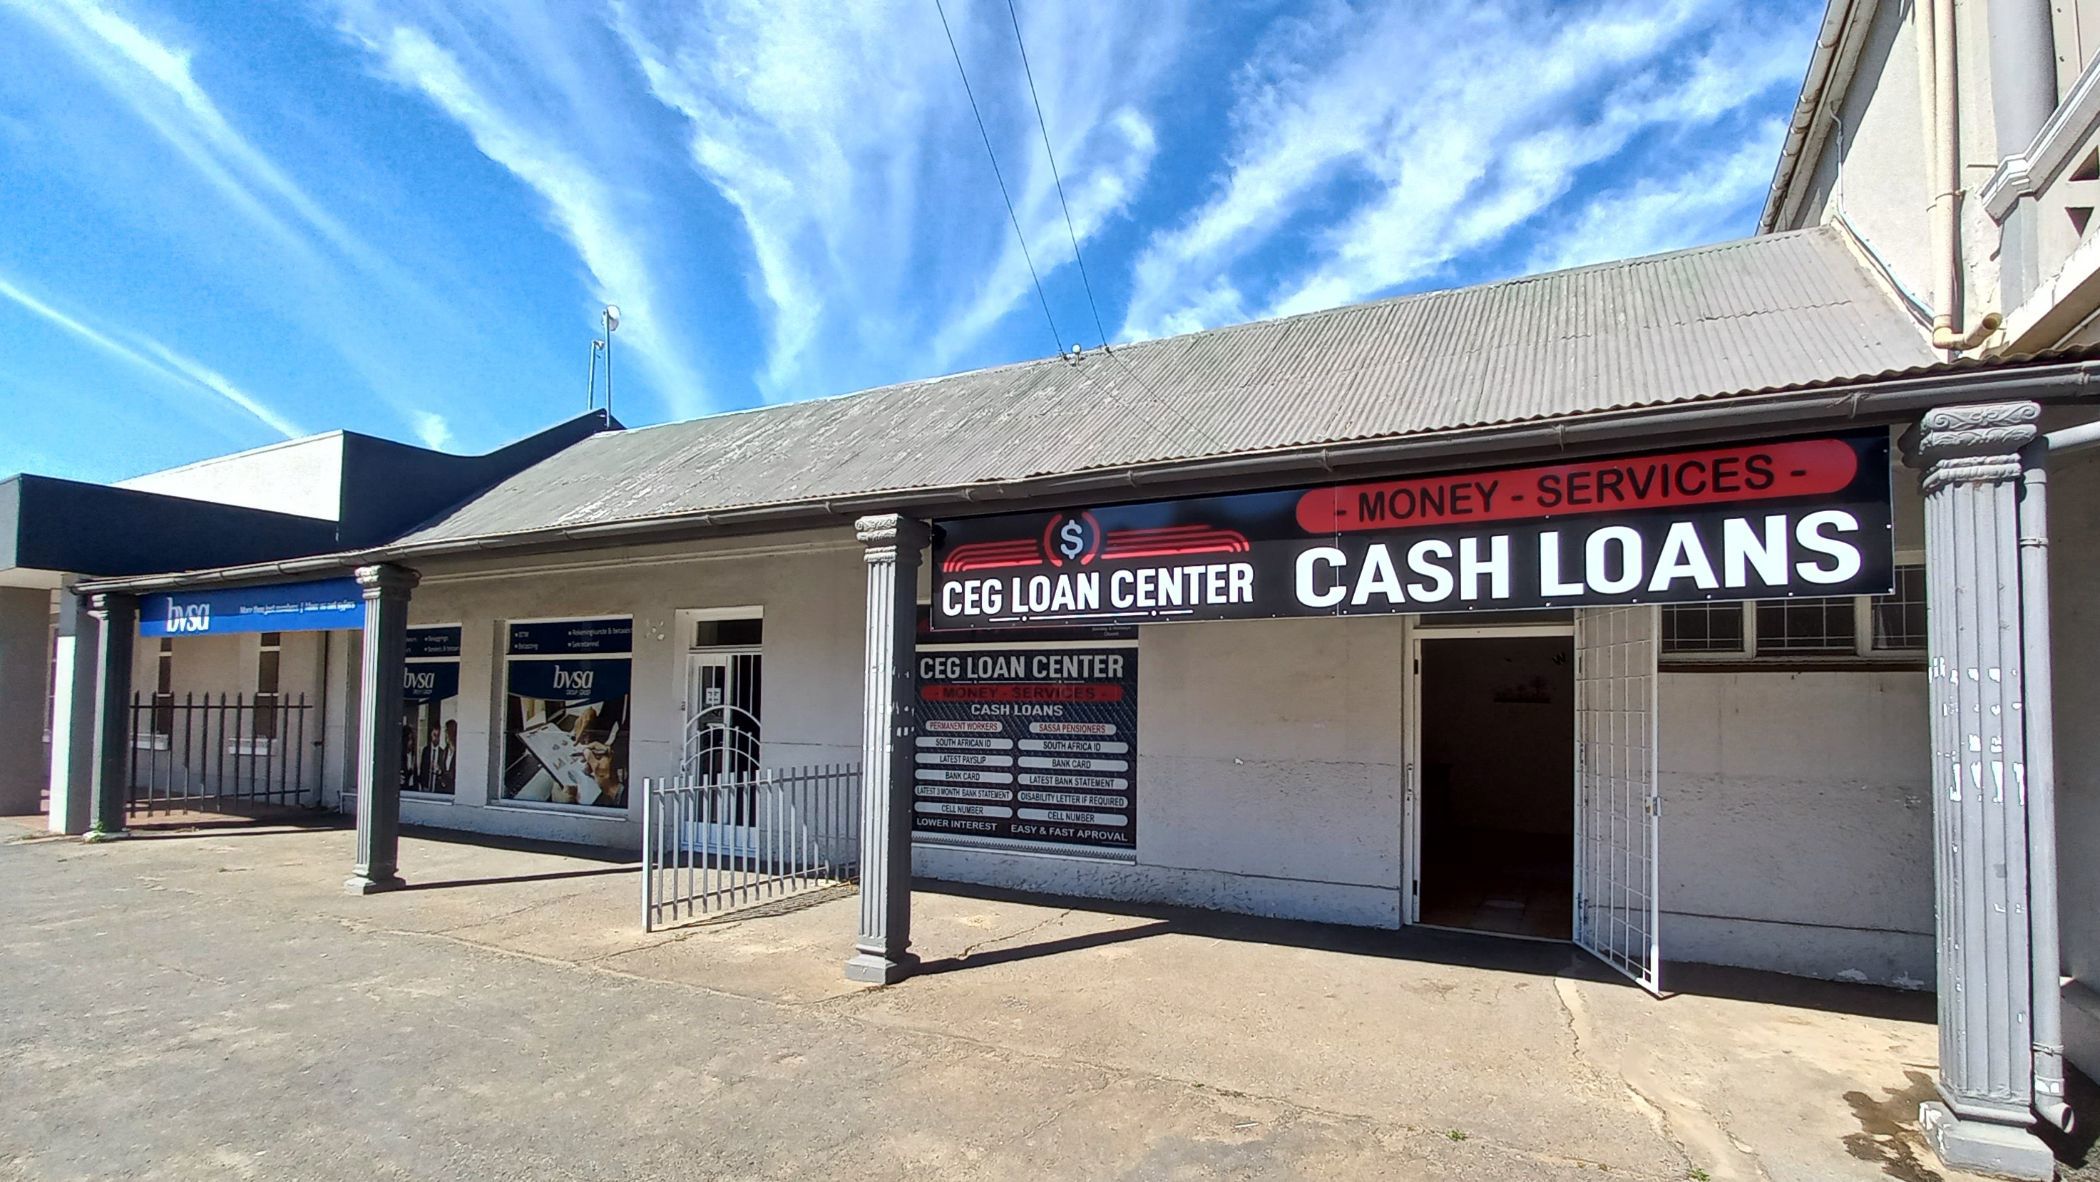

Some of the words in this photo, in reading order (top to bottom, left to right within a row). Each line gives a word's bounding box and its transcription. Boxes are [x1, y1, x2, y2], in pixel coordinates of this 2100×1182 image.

[1358, 481, 1499, 522] MONEY
[1535, 454, 1775, 508] SERVICES
[1294, 535, 1510, 608] CASH
[1539, 510, 1861, 597] LOANS
[942, 578, 1002, 616] CEG
[1011, 572, 1099, 613] LOAN
[1110, 562, 1254, 609] CENTER
[167, 597, 210, 632] bvsa
[920, 657, 960, 679] CEG
[967, 656, 1025, 678] LOAN
[1032, 654, 1124, 678] CENTER
[403, 667, 435, 688] bvsa
[553, 665, 594, 689] bvsa
[943, 687, 998, 698] MONEY
[1012, 686, 1095, 699] SERVICES
[971, 704, 1010, 715] CASH
[1013, 704, 1064, 716] LOANS
[929, 721, 966, 730] PERMANENT
[967, 722, 998, 731] WORKERS
[1039, 723, 1061, 732] SASSA
[1062, 724, 1106, 733] PENSIONERS
[935, 738, 956, 747] SOUTH
[957, 739, 983, 748] AFRICAN
[984, 739, 992, 748] ID
[1043, 741, 1066, 750] SOUTH
[1067, 742, 1092, 751] AFRICA
[1093, 742, 1101, 752] ID
[939, 755, 961, 764] LATEST
[962, 755, 986, 765] PAYSLIP
[1052, 759, 1071, 768] BANK
[1072, 759, 1091, 769] CARD
[945, 771, 962, 780] BANK
[963, 772, 980, 781] CARD
[1029, 775, 1053, 784] LATEST
[1054, 776, 1073, 785] BANK
[1074, 777, 1115, 788] STATEMENT
[916, 786, 935, 795] LATEST
[940, 788, 960, 797] MONTH
[961, 789, 977, 798] BANK
[978, 789, 1010, 800] STATEMENT
[1020, 792, 1055, 802] DISABILITY
[1056, 793, 1080, 804] LETTER
[1081, 795, 1087, 804] IF
[1089, 796, 1124, 807] REQUIRED
[941, 804, 957, 813] CELL
[957, 805, 984, 815] NUMBER
[1047, 811, 1064, 821] CELL
[1065, 812, 1095, 823] NUMBER
[916, 817, 949, 828] LOWER
[951, 820, 998, 831] INTEREST
[1010, 824, 1037, 834] EASY
[1039, 826, 1047, 835] &
[1049, 827, 1076, 837] FAST
[1077, 830, 1128, 841] APROVAL
